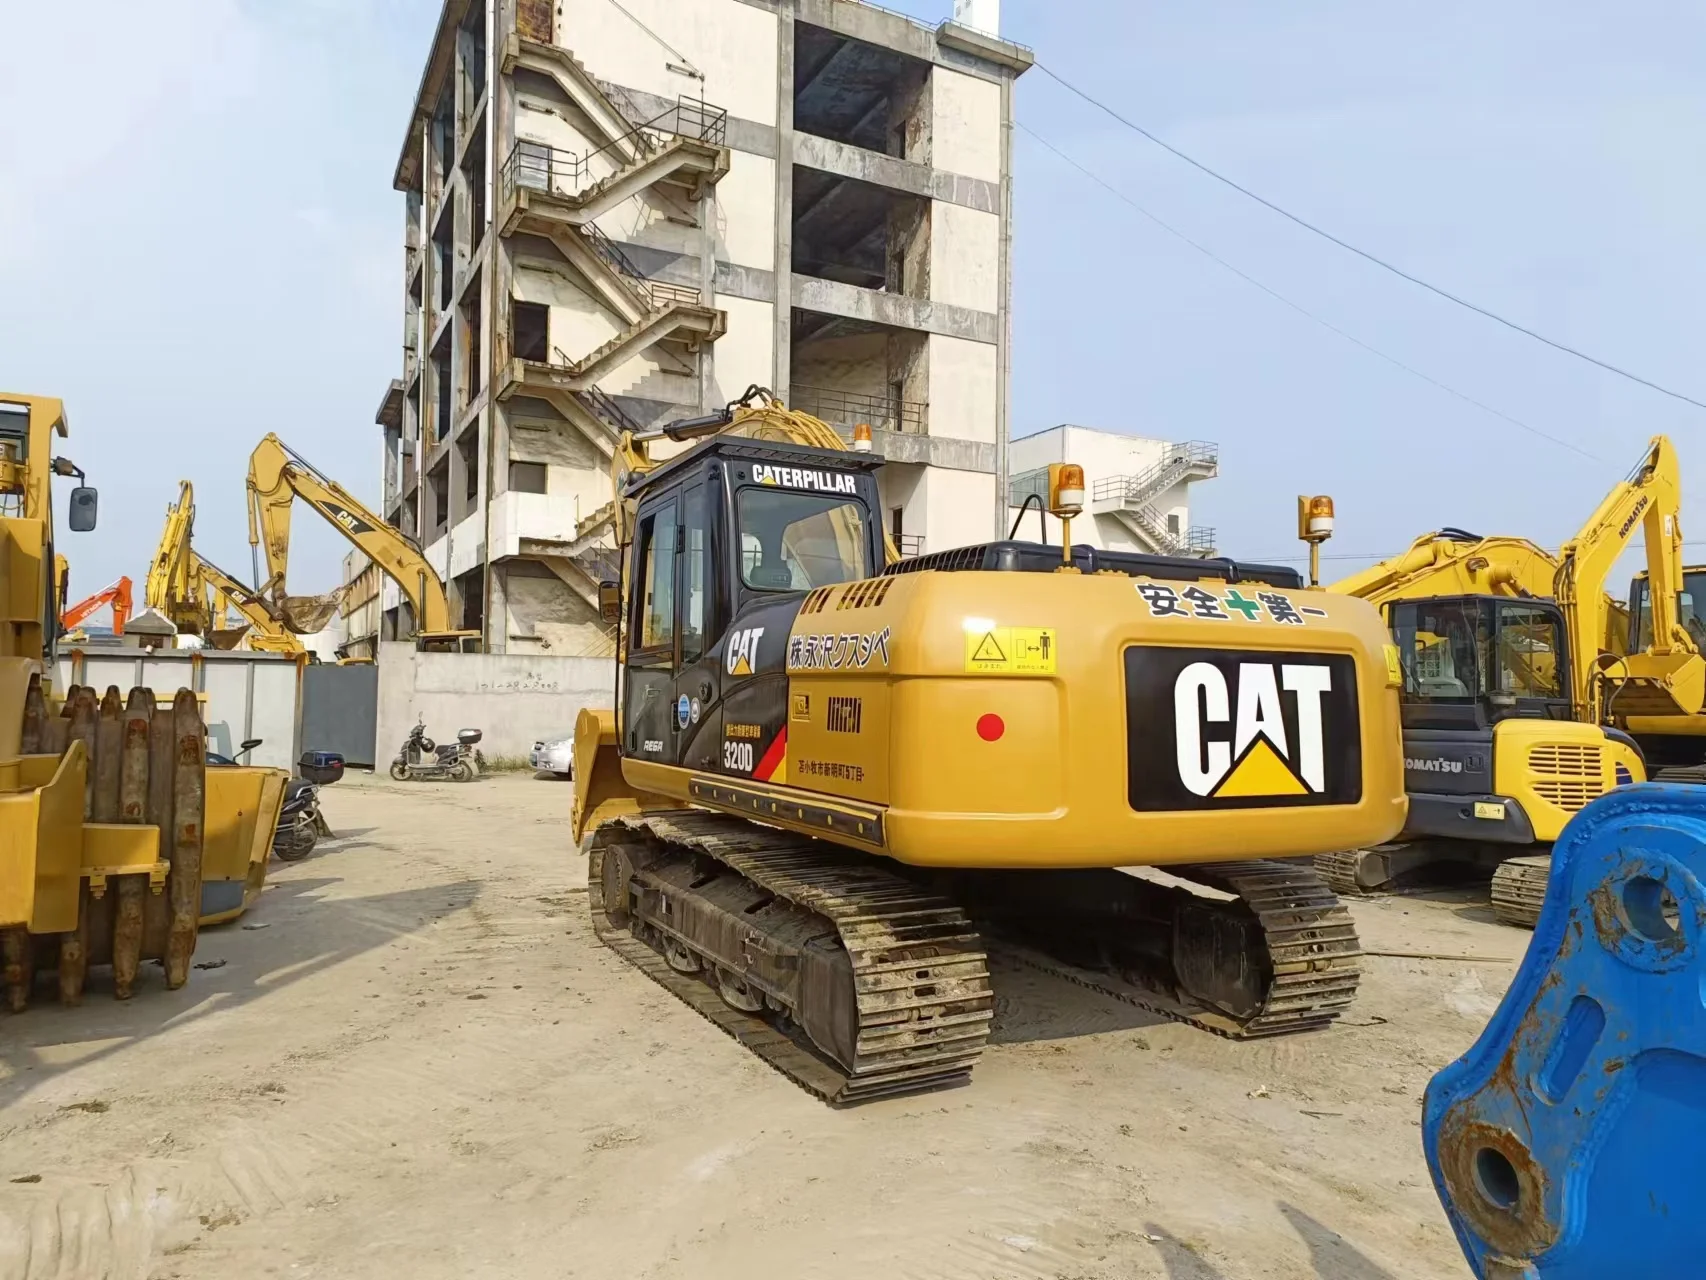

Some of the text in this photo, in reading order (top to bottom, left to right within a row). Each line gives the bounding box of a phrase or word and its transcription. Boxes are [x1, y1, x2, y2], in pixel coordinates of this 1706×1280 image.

[752, 464, 857, 494] CATERPILLAR
[336, 510, 359, 529] CAT
[1618, 495, 1648, 539] KOMATSU
[231, 590, 248, 604] CAT
[727, 626, 765, 675] CAT
[1174, 661, 1332, 797] CAT
[724, 740, 753, 771] 320D
[1404, 757, 1462, 773] OMATSU
